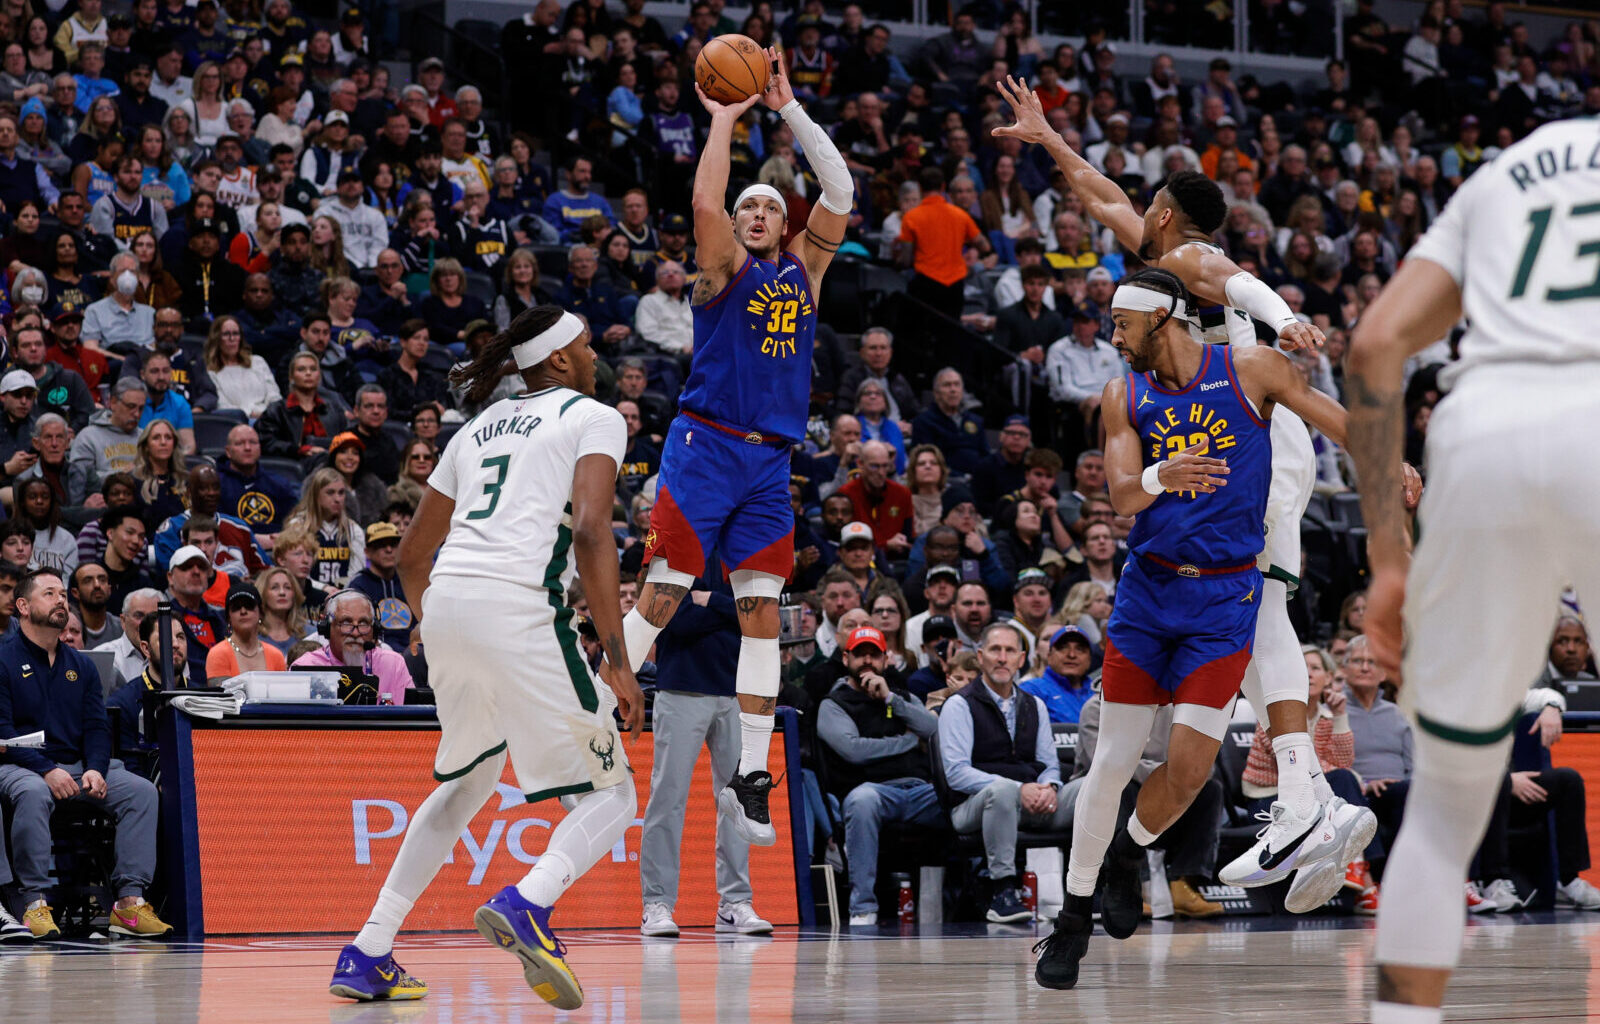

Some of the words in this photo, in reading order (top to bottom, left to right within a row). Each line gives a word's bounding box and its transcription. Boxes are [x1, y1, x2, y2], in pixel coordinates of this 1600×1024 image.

[1509, 144, 1600, 192] ROLL
[1509, 203, 1600, 302] 13
[778, 283, 811, 316] HIGH
[766, 300, 798, 334] 32
[760, 337, 796, 359] CITY
[1200, 380, 1229, 391] ibotta
[471, 415, 542, 447] TURNER
[1148, 407, 1181, 458] MILE
[1188, 403, 1236, 451] HIGH
[465, 454, 511, 521] 3
[1053, 732, 1079, 745] UM
[352, 799, 643, 886] Pycr
[1198, 885, 1247, 897] UMB
